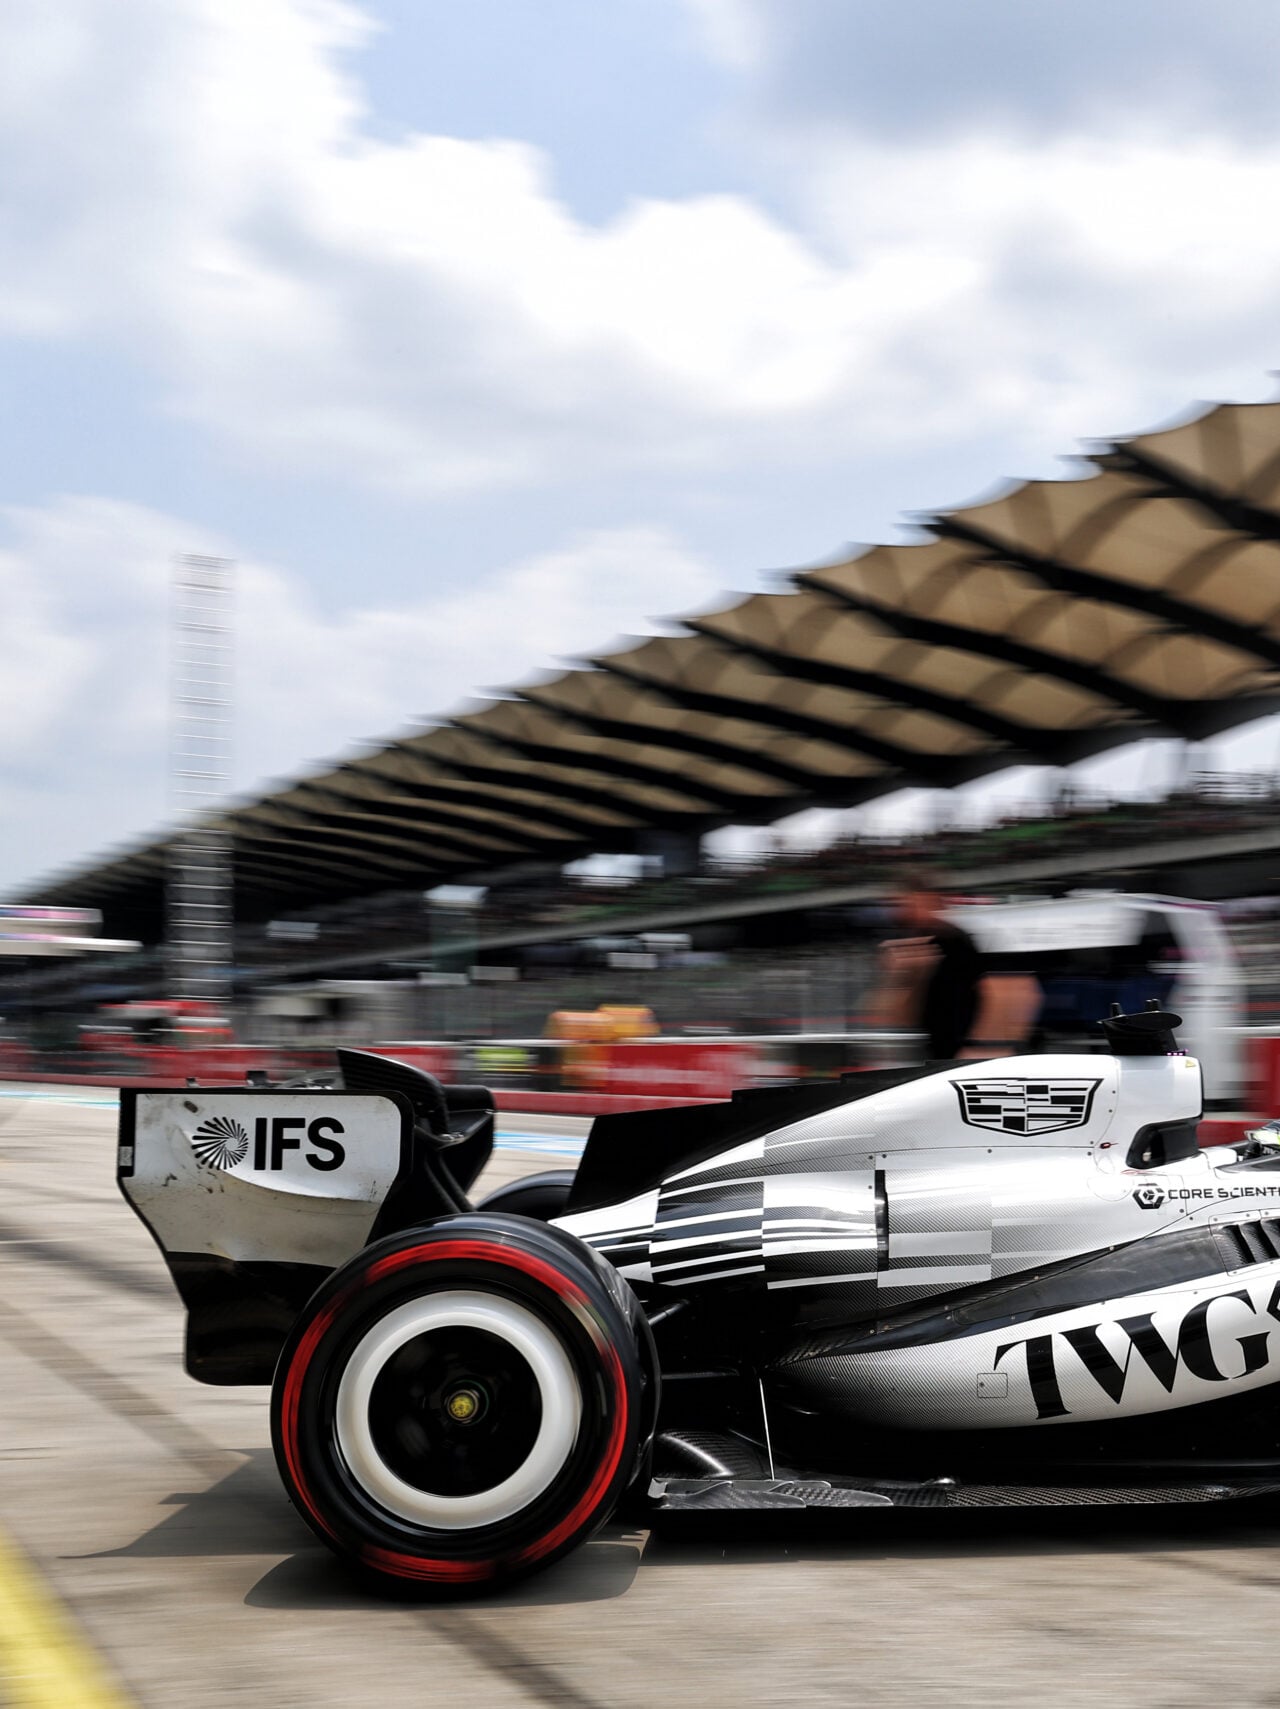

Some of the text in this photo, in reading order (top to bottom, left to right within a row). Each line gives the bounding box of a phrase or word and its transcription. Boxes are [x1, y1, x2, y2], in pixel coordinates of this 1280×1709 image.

[253, 1116, 346, 1172] IFS
[1168, 1188, 1214, 1200] CORE
[993, 1288, 1271, 1420] TWG
